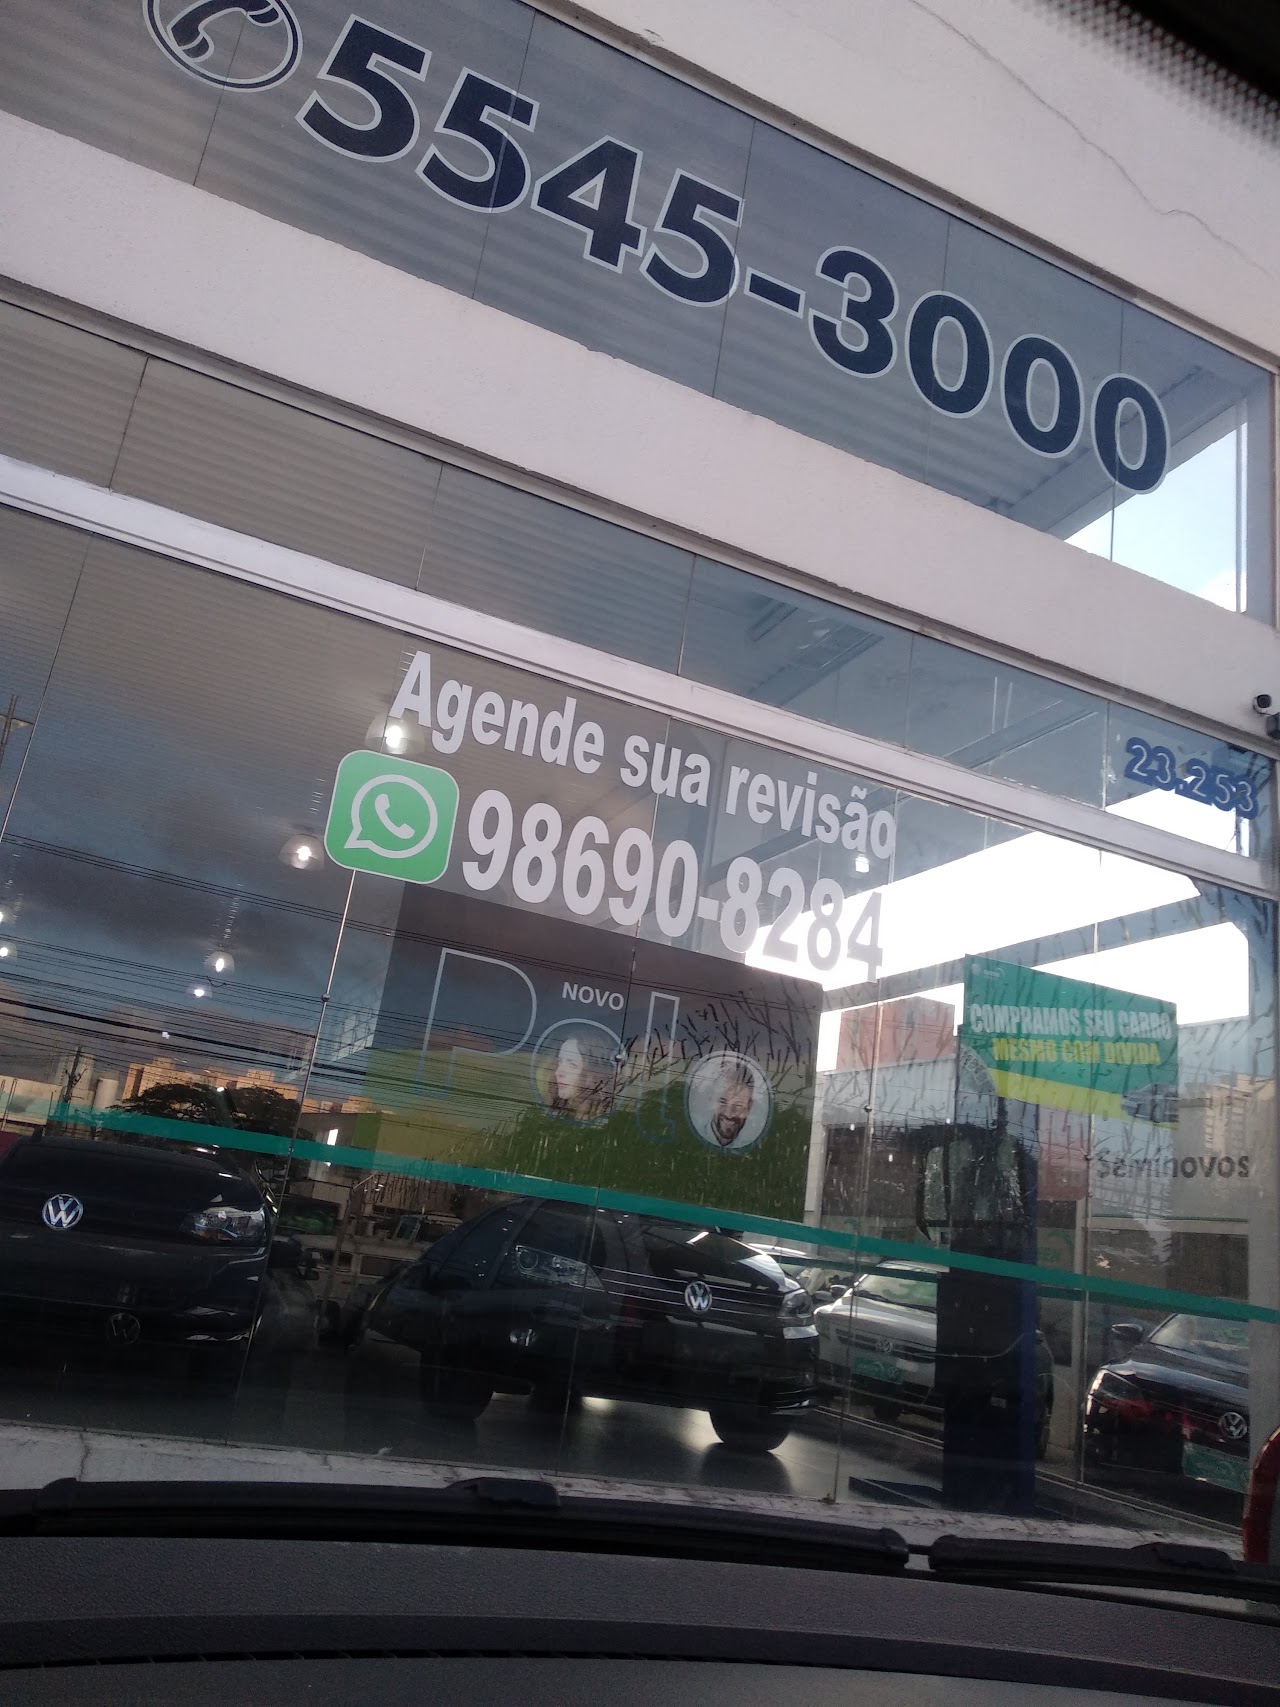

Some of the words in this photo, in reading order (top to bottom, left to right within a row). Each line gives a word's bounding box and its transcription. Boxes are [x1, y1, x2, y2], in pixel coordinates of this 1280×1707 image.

[296, 14, 1170, 494] 5545-3000
[388, 651, 604, 774] Agende
[619, 734, 711, 807] sua
[725, 765, 897, 860] revisão
[1124, 737, 1259, 820] 23.253
[462, 789, 884, 984] 98690-8284
[562, 981, 625, 1012] NOVO
[969, 1003, 1082, 1037] COMPRAMOS
[1083, 1008, 1116, 1038] SEU
[1117, 1010, 1173, 1039] CARRO
[992, 1038, 1058, 1063] MESMO
